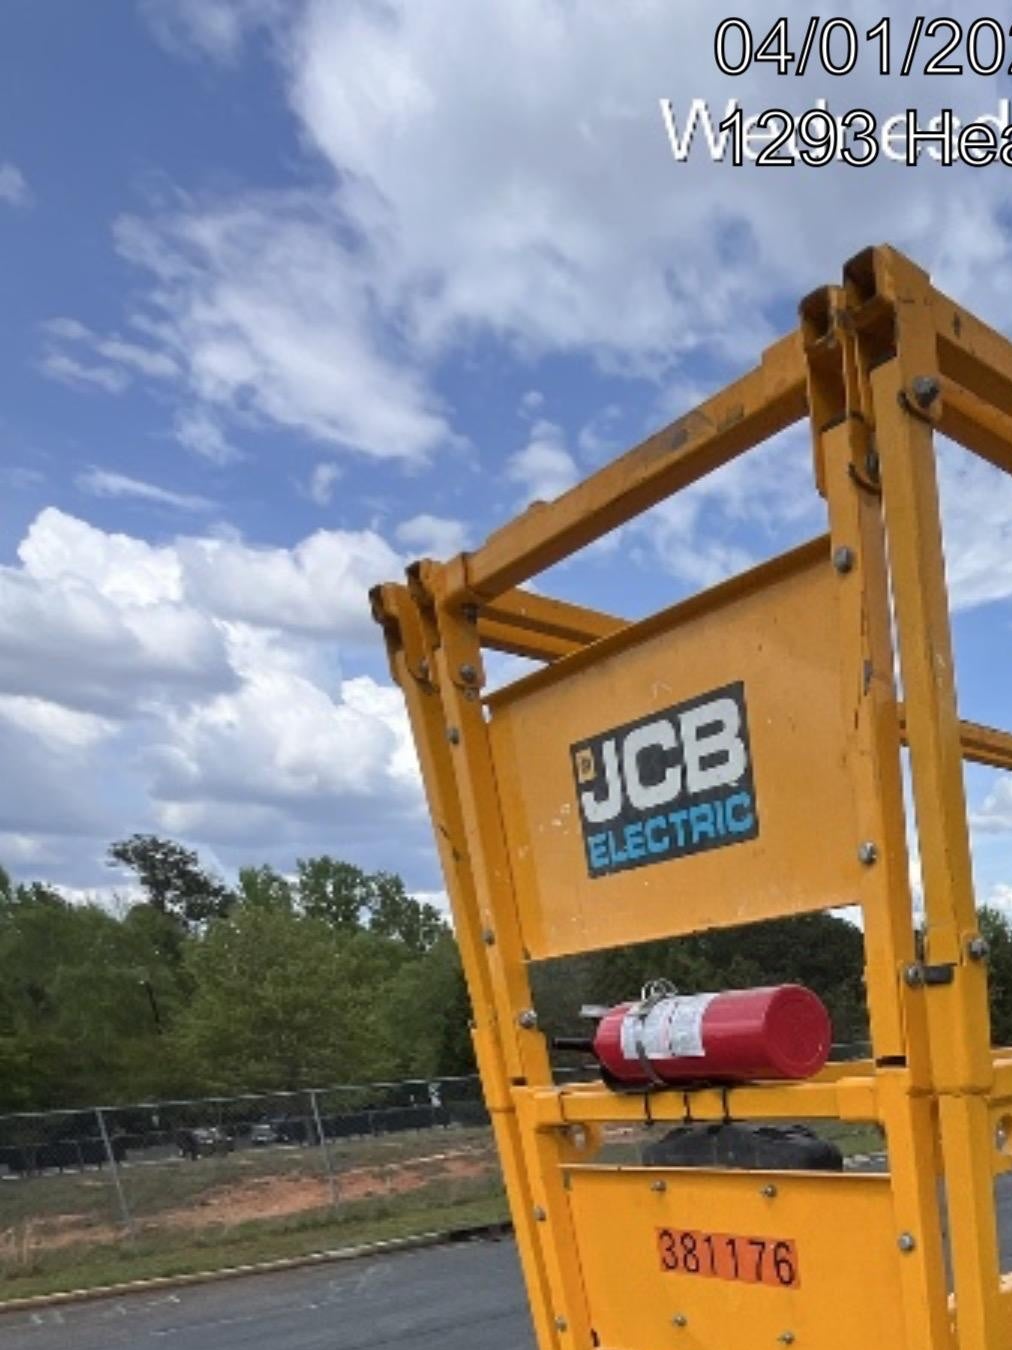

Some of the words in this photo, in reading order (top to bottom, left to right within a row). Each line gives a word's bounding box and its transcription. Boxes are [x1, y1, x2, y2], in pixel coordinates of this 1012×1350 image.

[580, 697, 748, 824] JCB
[587, 790, 754, 870] ELECTRIC
[658, 1229, 795, 1286] 381176
